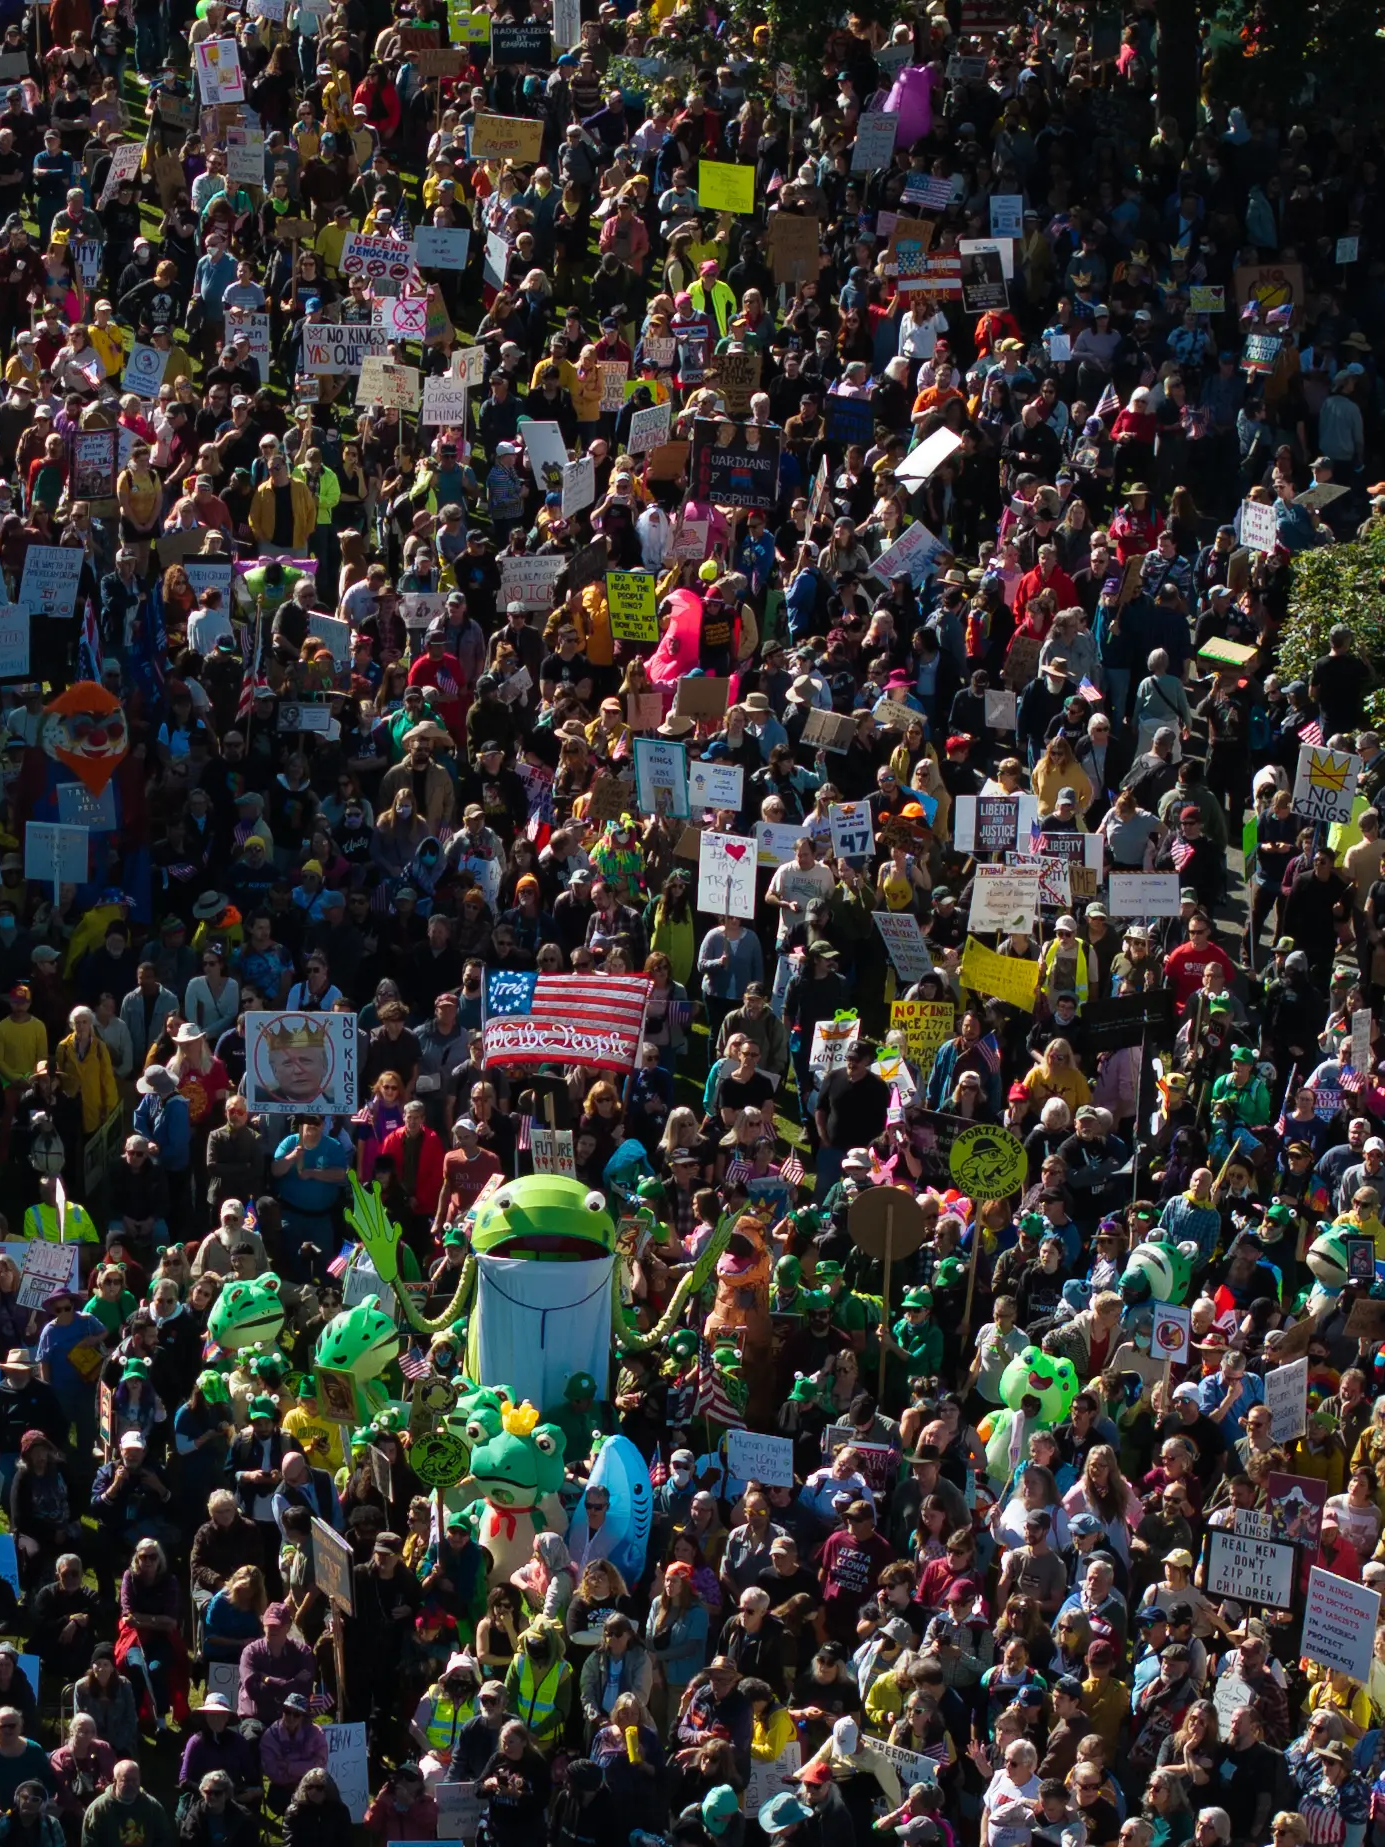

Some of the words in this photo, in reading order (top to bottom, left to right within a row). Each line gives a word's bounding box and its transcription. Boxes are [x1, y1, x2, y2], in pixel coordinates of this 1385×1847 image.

[493, 27, 550, 36] RADICALIZED
[500, 41, 541, 49] EMPATHY
[354, 236, 408, 252] DEFEND
[348, 246, 410, 264] DEMOCRACY
[1259, 269, 1285, 282] NO
[908, 289, 949, 301] POWER
[326, 328, 343, 344] NO
[347, 329, 388, 345] KINGS
[306, 345, 331, 365] YAS
[717, 357, 750, 368] STOP
[427, 392, 462, 404] CLOSER
[425, 409, 463, 421] THINK
[526, 562, 533, 570] MY
[614, 574, 623, 583] DO
[631, 574, 645, 584] YOU
[504, 584, 524, 603] NO
[527, 583, 554, 602] ICE
[610, 582, 631, 592] HEAR
[636, 583, 650, 592] THE
[617, 592, 644, 601] PEOPLE
[642, 614, 655, 622] NOT
[649, 756, 672, 765] KINGS
[712, 767, 736, 777] RESIST
[1308, 785, 1339, 806] NO
[980, 803, 1015, 817] LIBERTY
[1292, 798, 1351, 824] KINGS
[979, 824, 1015, 838] JUSTICE
[839, 831, 869, 853] 47
[1045, 840, 1082, 854] LIBERTY
[978, 867, 1006, 877] TRUMP
[494, 981, 522, 996] 1776
[894, 1006, 912, 1019] NO
[916, 1007, 954, 1017] KINGS
[342, 1015, 355, 1041] NO
[892, 1020, 922, 1030] SINCE
[924, 1019, 951, 1030] 1776
[552, 1024, 630, 1062] People
[825, 1044, 842, 1053] NO
[814, 1054, 849, 1063] KINGS
[343, 1049, 355, 1107] KINGS
[958, 1124, 1022, 1157] PORTLAND
[952, 1169, 973, 1198] FROG
[975, 1176, 1022, 1200] BRIGADE
[734, 1438, 764, 1453] Human
[1243, 1511, 1259, 1524] NO
[1234, 1521, 1269, 1539] KINGS
[1221, 1536, 1249, 1551] REAL
[1255, 1545, 1276, 1560] MEN
[1234, 1554, 1266, 1571] DON'T
[1222, 1564, 1243, 1580] ZIP
[1251, 1573, 1272, 1588] TIE
[1215, 1579, 1283, 1606] CHILDREN!
[1313, 1579, 1324, 1589] NO
[1328, 1585, 1353, 1602] KINGS
[1311, 1591, 1323, 1601] NO
[1324, 1594, 1371, 1621] DICTATORS
[1309, 1604, 1320, 1614] NO
[1323, 1608, 1360, 1630] FASCISTS
[1308, 1616, 1317, 1626] IN
[1320, 1622, 1357, 1642] AMERICA
[1307, 1630, 1343, 1651] PROTECT
[1304, 1644, 1354, 1671] DEMOCRACY
[871, 1740, 918, 1766] FREEDOM
